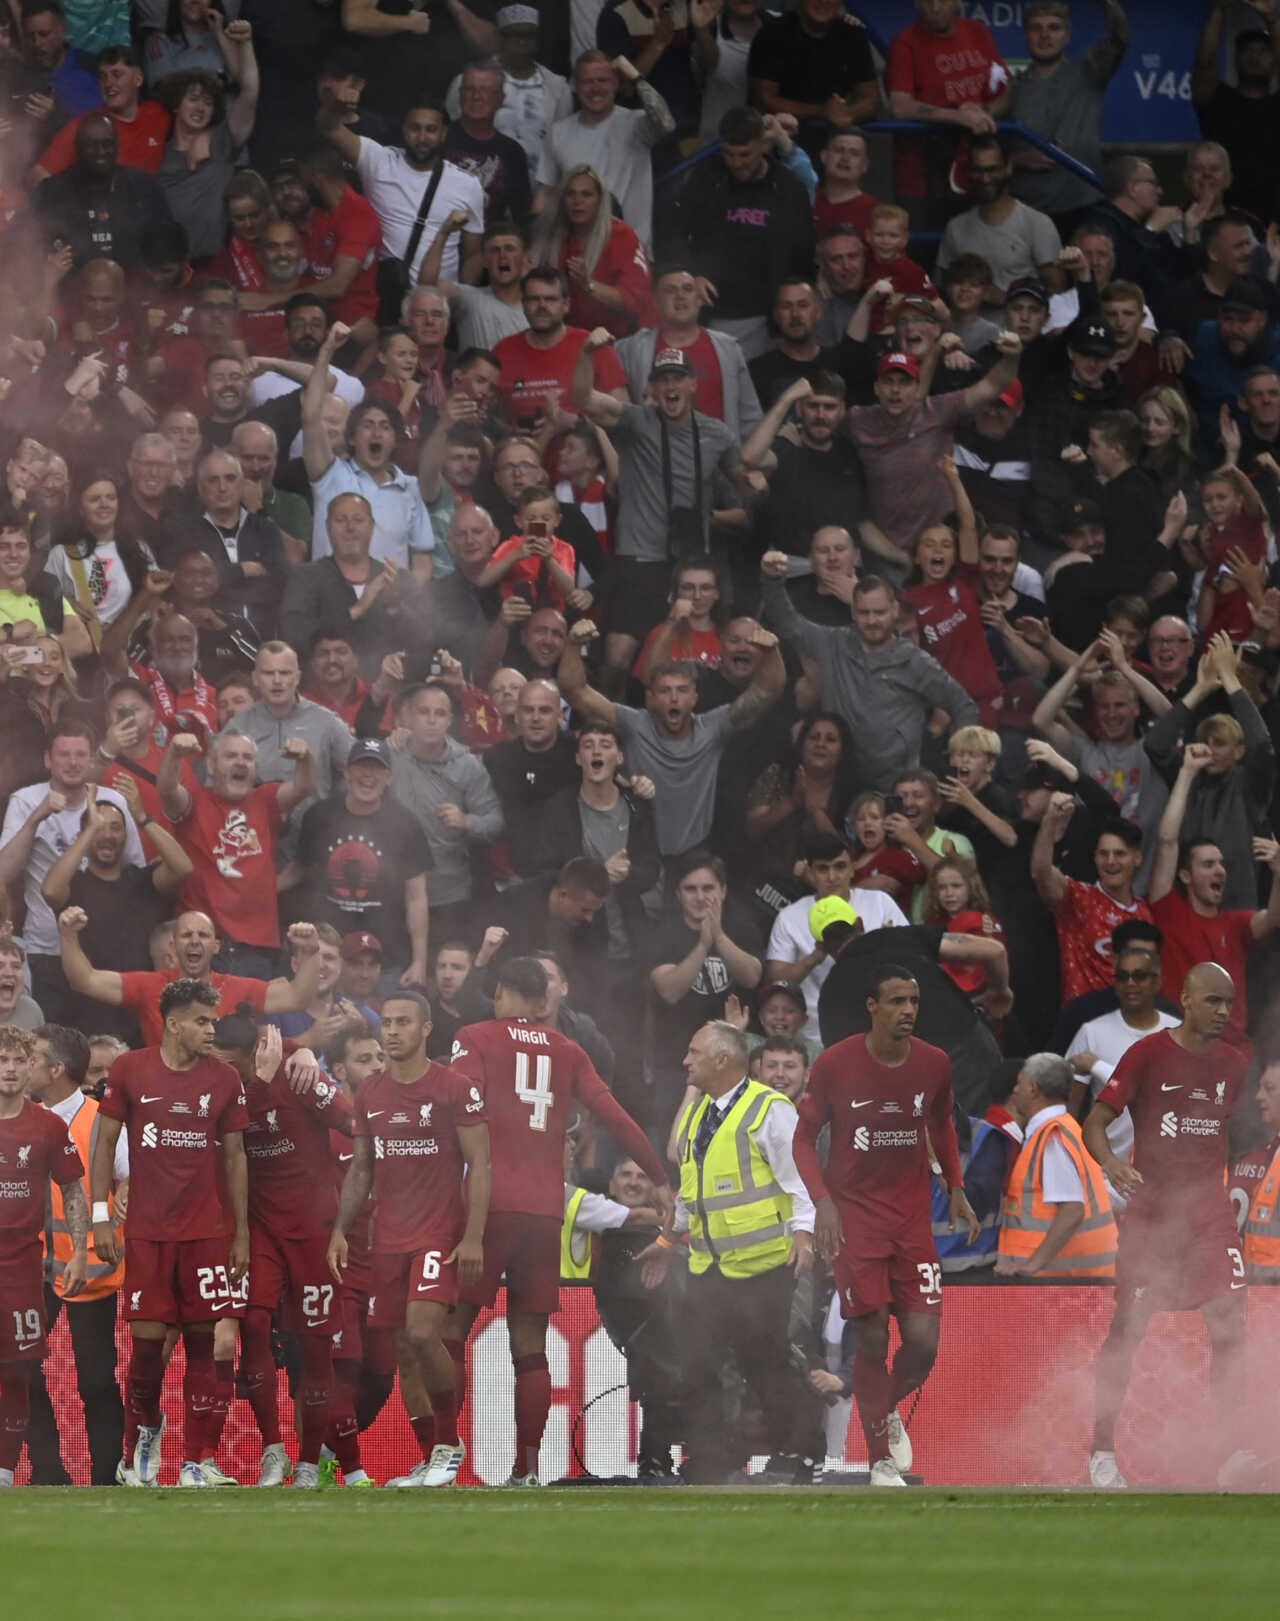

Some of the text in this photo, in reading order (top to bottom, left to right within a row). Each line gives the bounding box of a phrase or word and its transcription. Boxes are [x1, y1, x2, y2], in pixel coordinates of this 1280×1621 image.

[507, 1025, 551, 1046] VIRGIL
[514, 1051, 555, 1132] 4
[161, 1138, 208, 1149] chartered
[387, 1139, 435, 1149] standard
[873, 1129, 918, 1138] standard
[873, 1137, 919, 1147] chartered
[387, 1145, 439, 1157] chartered
[423, 1250, 441, 1280] 6
[197, 1266, 230, 1300] 23
[303, 1285, 334, 1316] 27
[13, 1309, 41, 1341] 19
